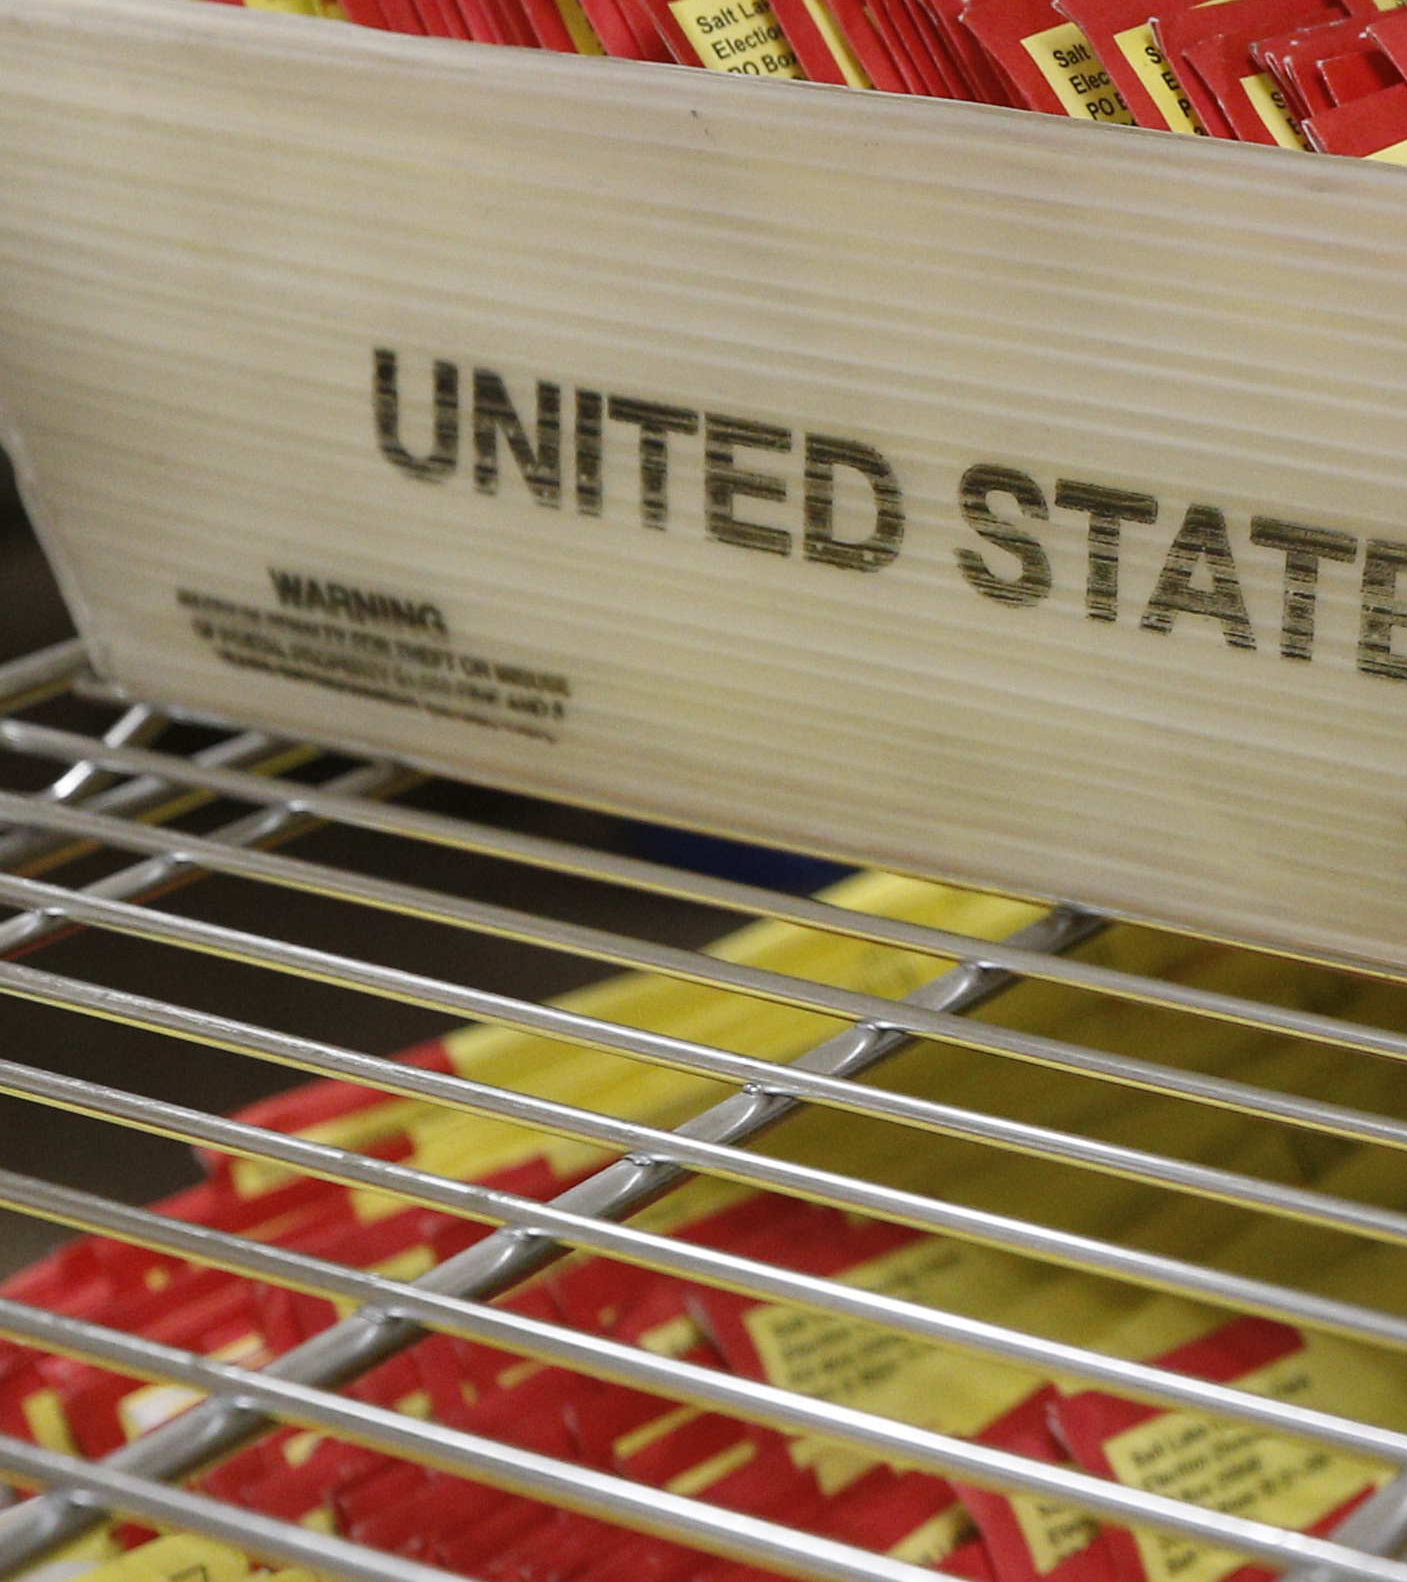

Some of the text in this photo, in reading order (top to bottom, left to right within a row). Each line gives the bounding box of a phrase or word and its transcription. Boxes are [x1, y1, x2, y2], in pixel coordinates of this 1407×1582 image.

[696, 5, 740, 35] Salt
[1052, 43, 1092, 68] Salt
[1085, 97, 1117, 121] PO
[372, 347, 906, 574] UNITED
[268, 565, 450, 641] WARNING
